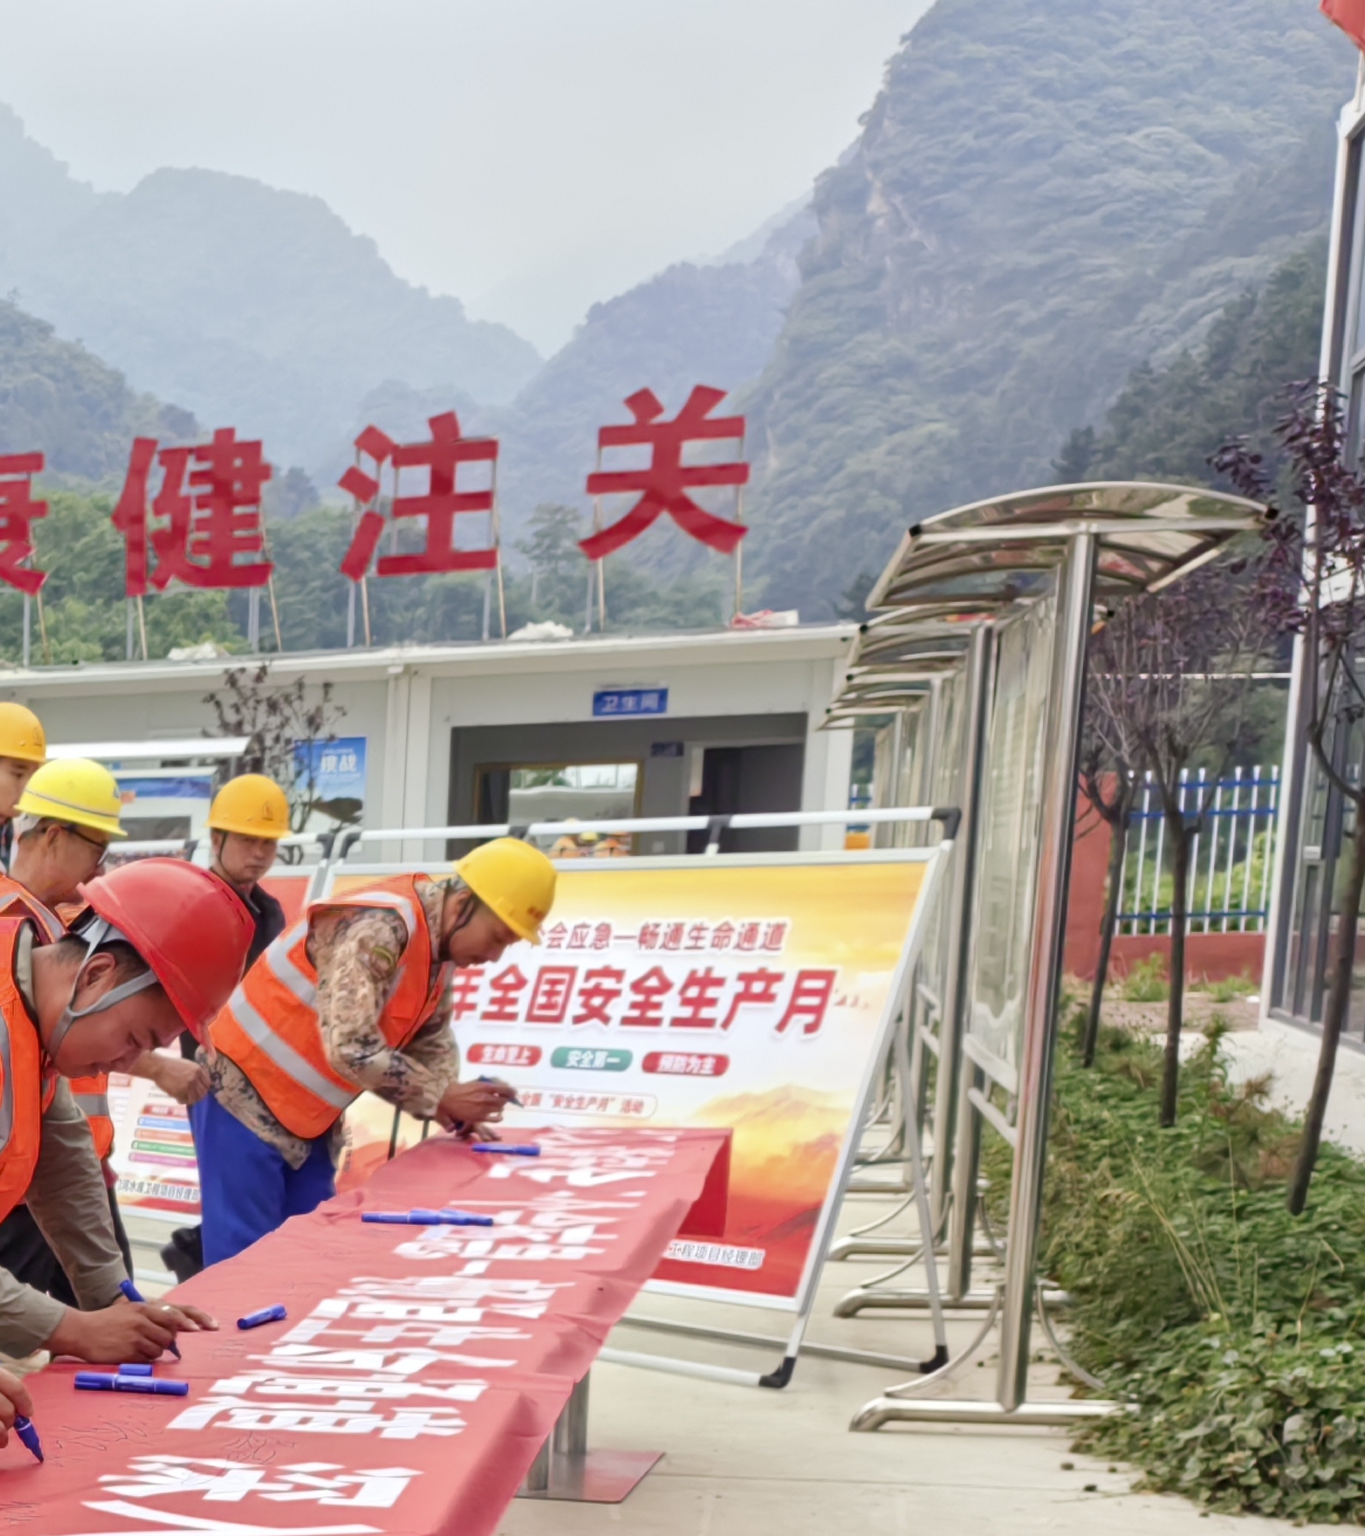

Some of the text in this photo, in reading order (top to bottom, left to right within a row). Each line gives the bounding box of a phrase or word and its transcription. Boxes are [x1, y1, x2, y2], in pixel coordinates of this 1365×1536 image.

[600, 692, 660, 712] 卫生间
[538, 921, 788, 951] 会应急—畅通生命通道
[481, 1045, 716, 1074] 生命至上 安全第一 预防为主
